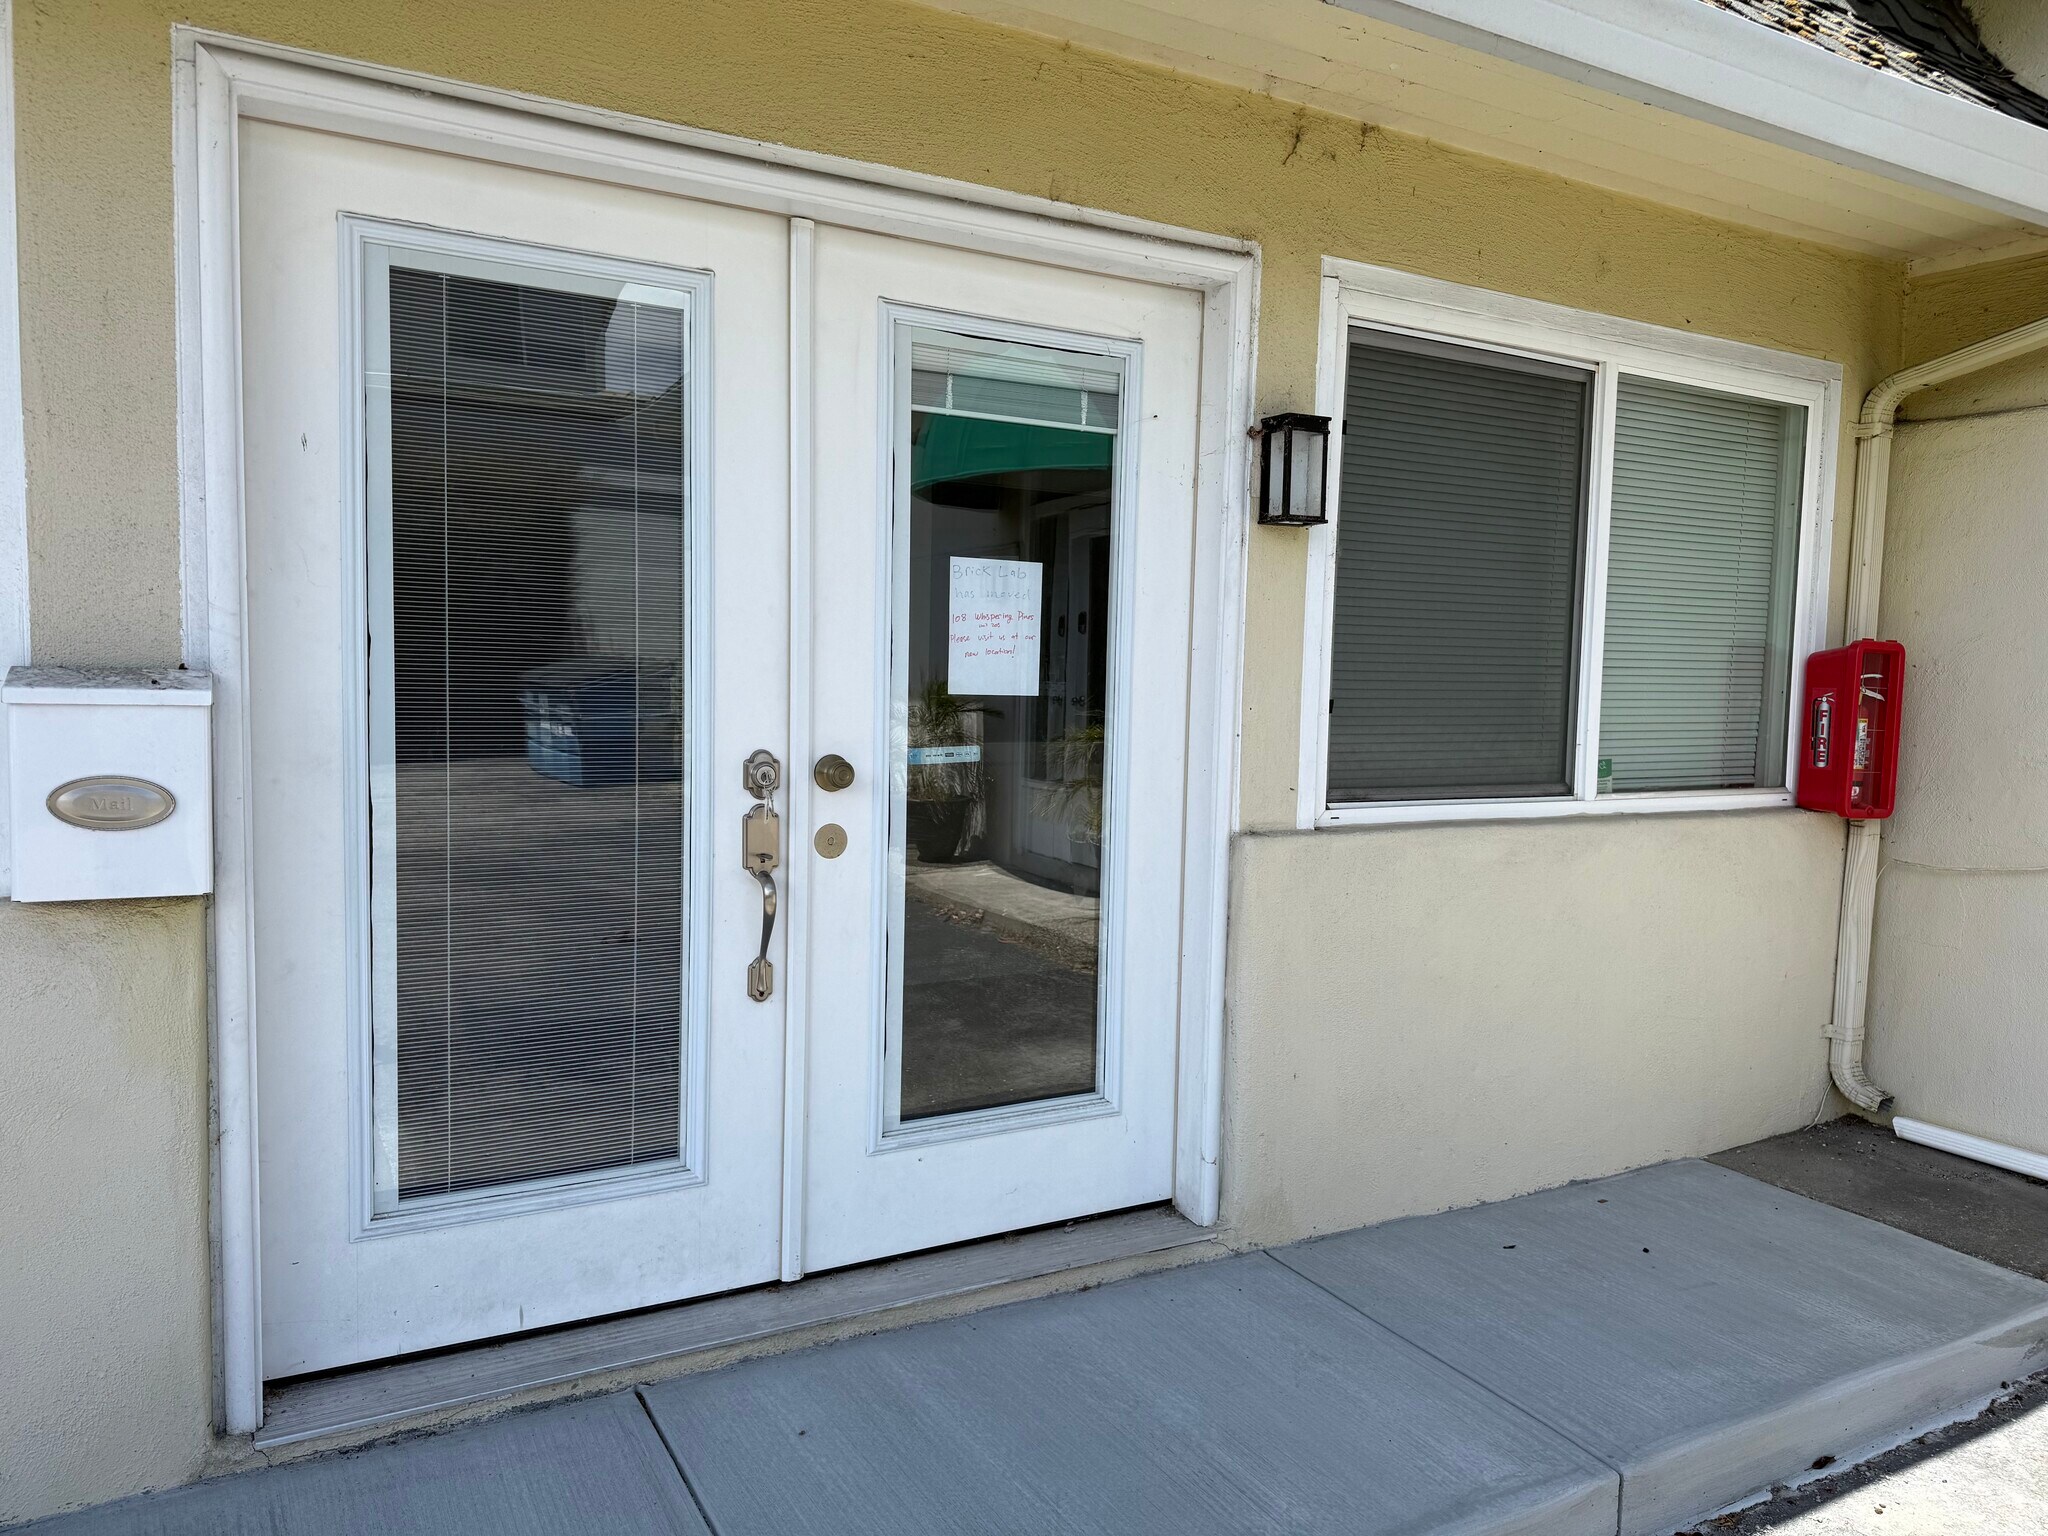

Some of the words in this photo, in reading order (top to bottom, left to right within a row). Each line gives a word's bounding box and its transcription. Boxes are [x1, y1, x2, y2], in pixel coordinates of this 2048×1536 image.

[999, 565, 1027, 579] Lab
[955, 587, 975, 599] has
[986, 588, 1031, 600] moved
[952, 613, 967, 624] 108
[950, 633, 970, 643] Please
[1011, 632, 1018, 640] at
[1817, 709, 1828, 763] FIRE
[91, 797, 134, 811] Mail
